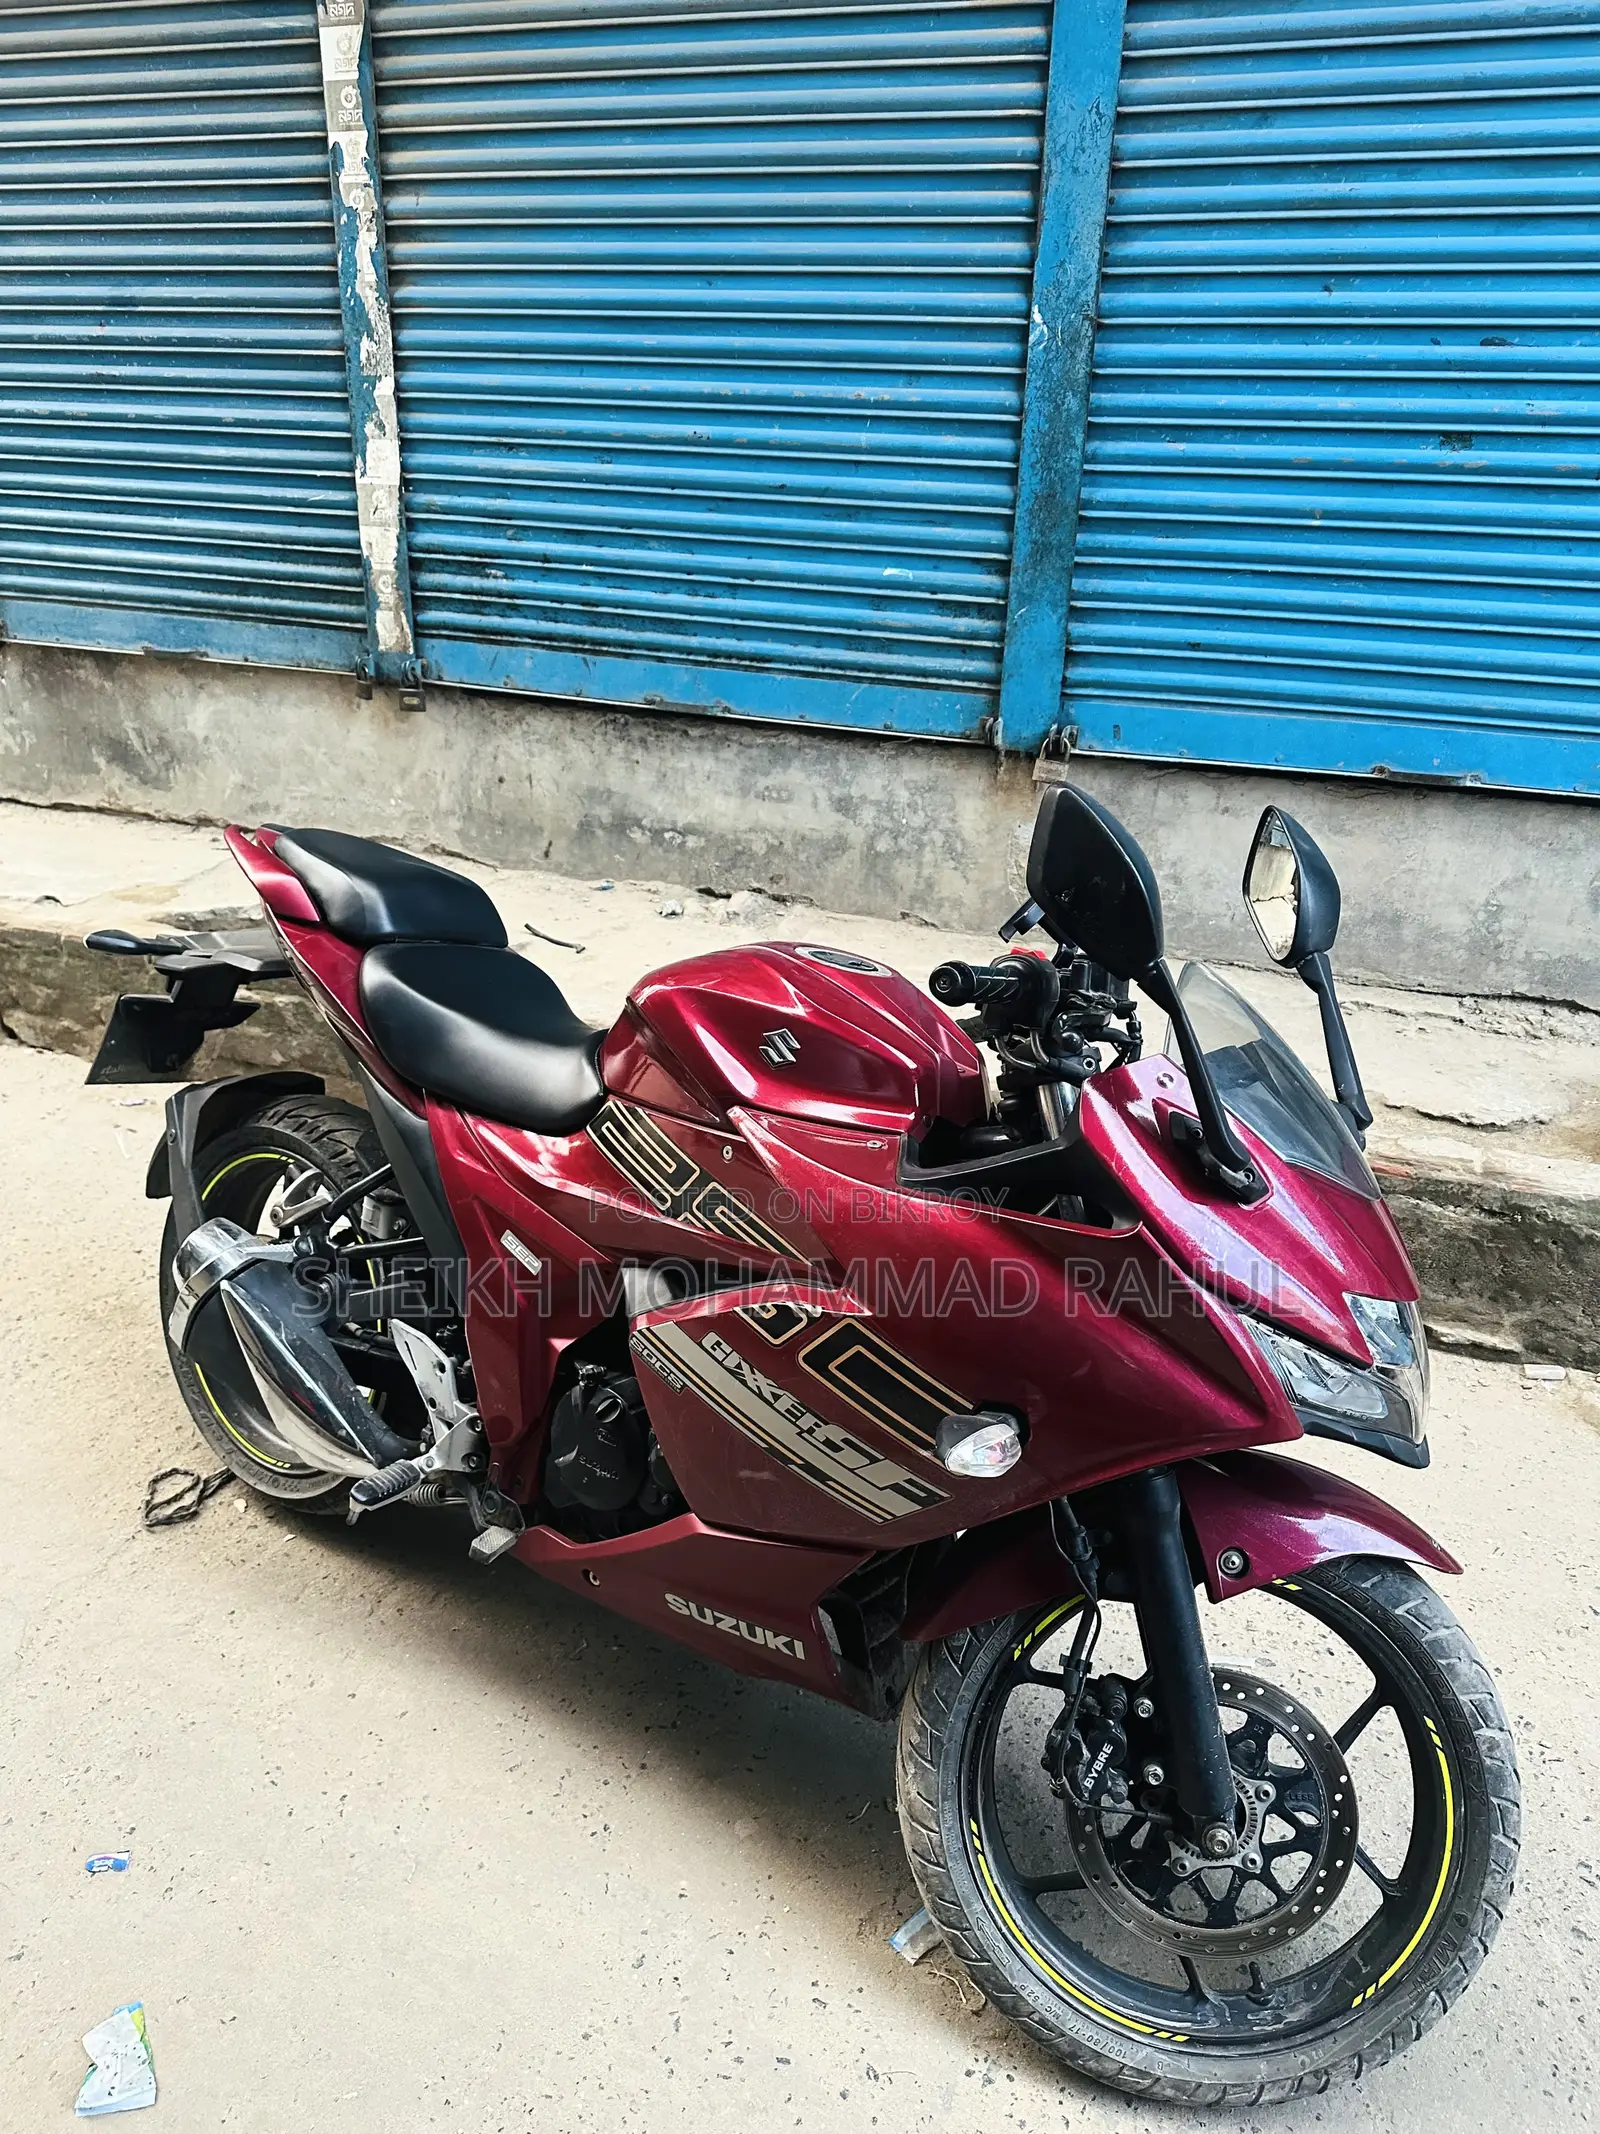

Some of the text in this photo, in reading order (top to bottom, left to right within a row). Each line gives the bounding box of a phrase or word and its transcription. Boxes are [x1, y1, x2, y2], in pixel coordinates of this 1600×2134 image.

[505, 1235, 540, 1266] SEP
[629, 1336, 684, 1388] SOCS
[665, 1593, 806, 1660] SUZUKI
[968, 1617, 1015, 1685] MRF
[1083, 1741, 1115, 1790] BYBRE
[1044, 2005, 1062, 2021] M/C
[1068, 2024, 1127, 2060] 100/80-17
